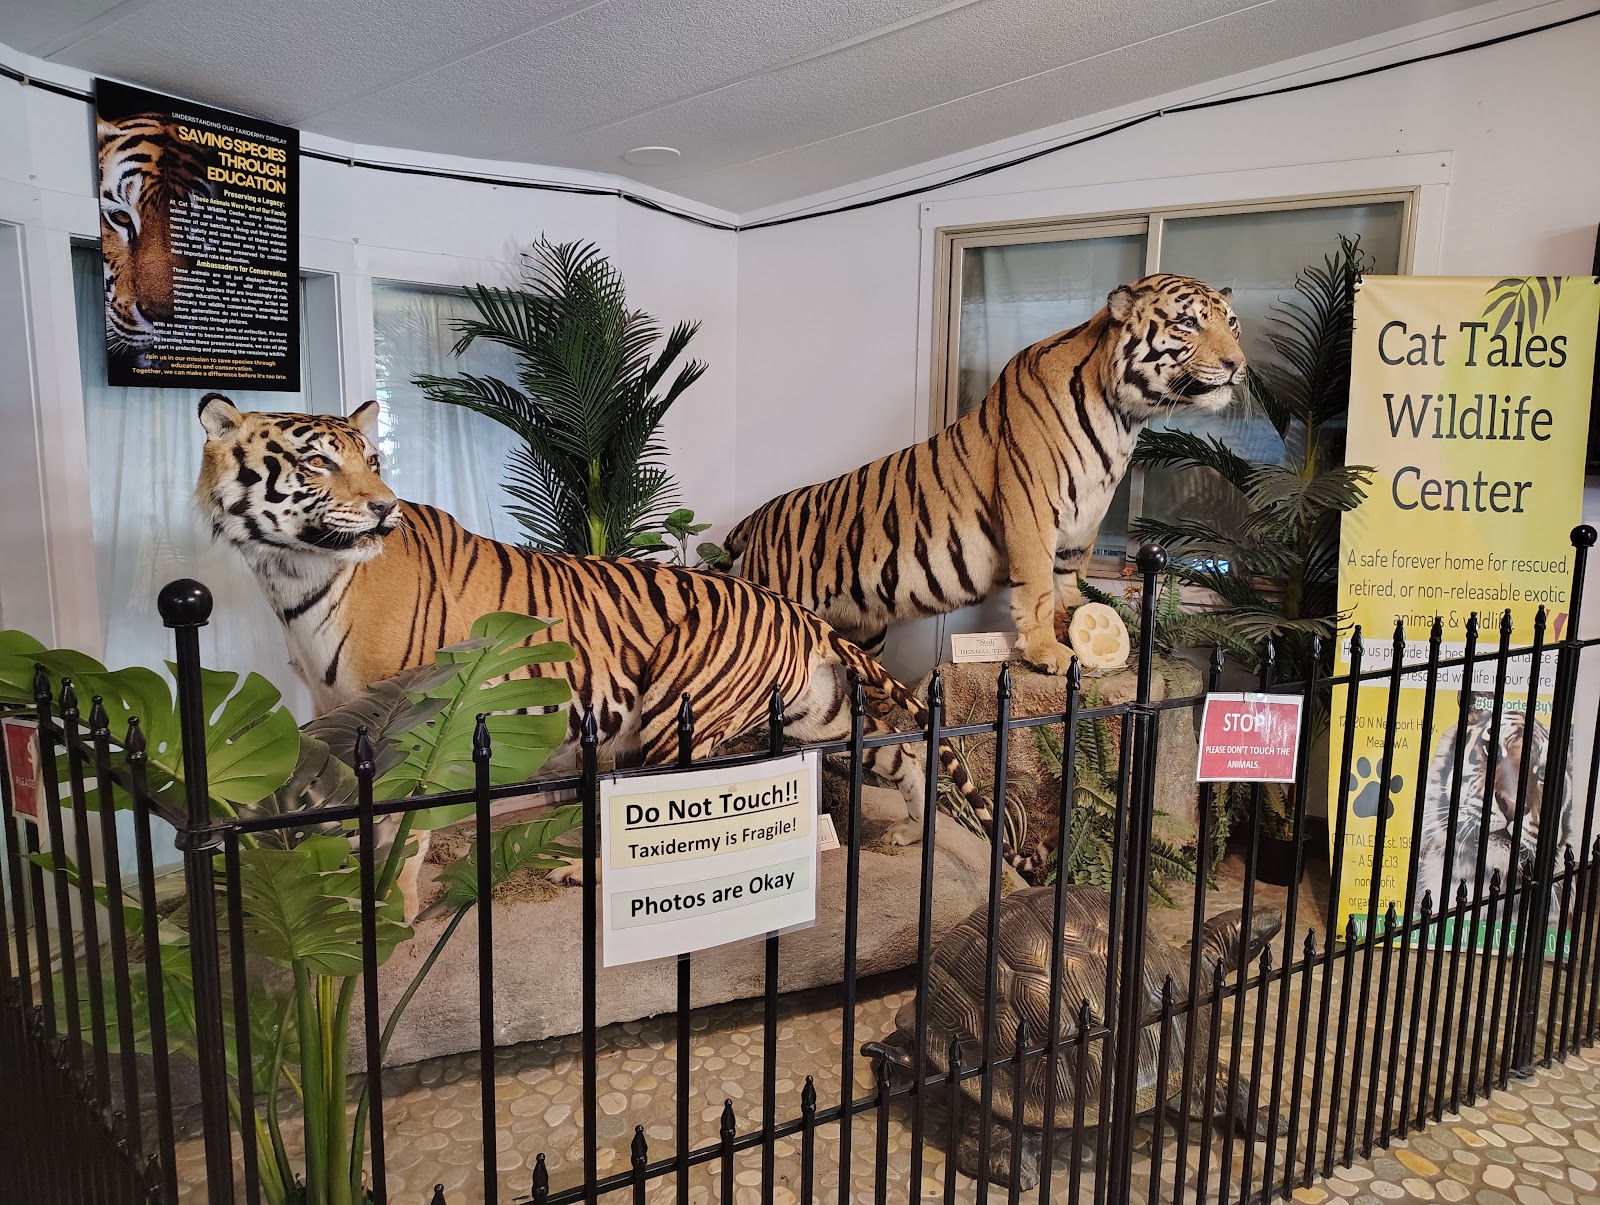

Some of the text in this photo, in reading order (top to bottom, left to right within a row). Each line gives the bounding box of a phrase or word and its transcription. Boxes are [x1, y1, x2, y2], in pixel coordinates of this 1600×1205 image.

[172, 112, 286, 145] UNDERSTANDING OUR TAXIDERMY DISPLAY
[179, 126, 286, 163] SAVING SPECIES
[218, 152, 285, 179] THROUGH
[208, 166, 285, 194] EDUCATION
[192, 195, 209, 203] These
[210, 198, 230, 207] Animals
[271, 209, 286, 218] Family
[224, 190, 257, 203] Preserving
[196, 260, 238, 271] Ambassadors
[249, 267, 286, 278] Conservation
[1378, 320, 1568, 368] Cat Tales
[1382, 393, 1553, 441] Wildlife
[1391, 465, 1533, 513] Center
[1347, 549, 1570, 576] A safe forever home for rescued,
[1348, 579, 1566, 603] retired, or non-releasable exotic
[1448, 610, 1459, 628] &
[1368, 648, 1380, 656] us
[1446, 645, 1466, 660] bes
[1505, 676, 1524, 686] our
[1222, 712, 1265, 733] STOP
[1367, 716, 1374, 728] N
[1376, 717, 1414, 732] Neport
[1205, 745, 1290, 756] PLEASE DON'T TOUCH THE
[1226, 760, 1261, 769] ANIMALS.
[625, 780, 798, 825] Do Not Touch!!
[628, 817, 797, 860] Taxidermy is Fragile!
[1358, 854, 1365, 866] A
[631, 871, 795, 918] Photos are Okay
